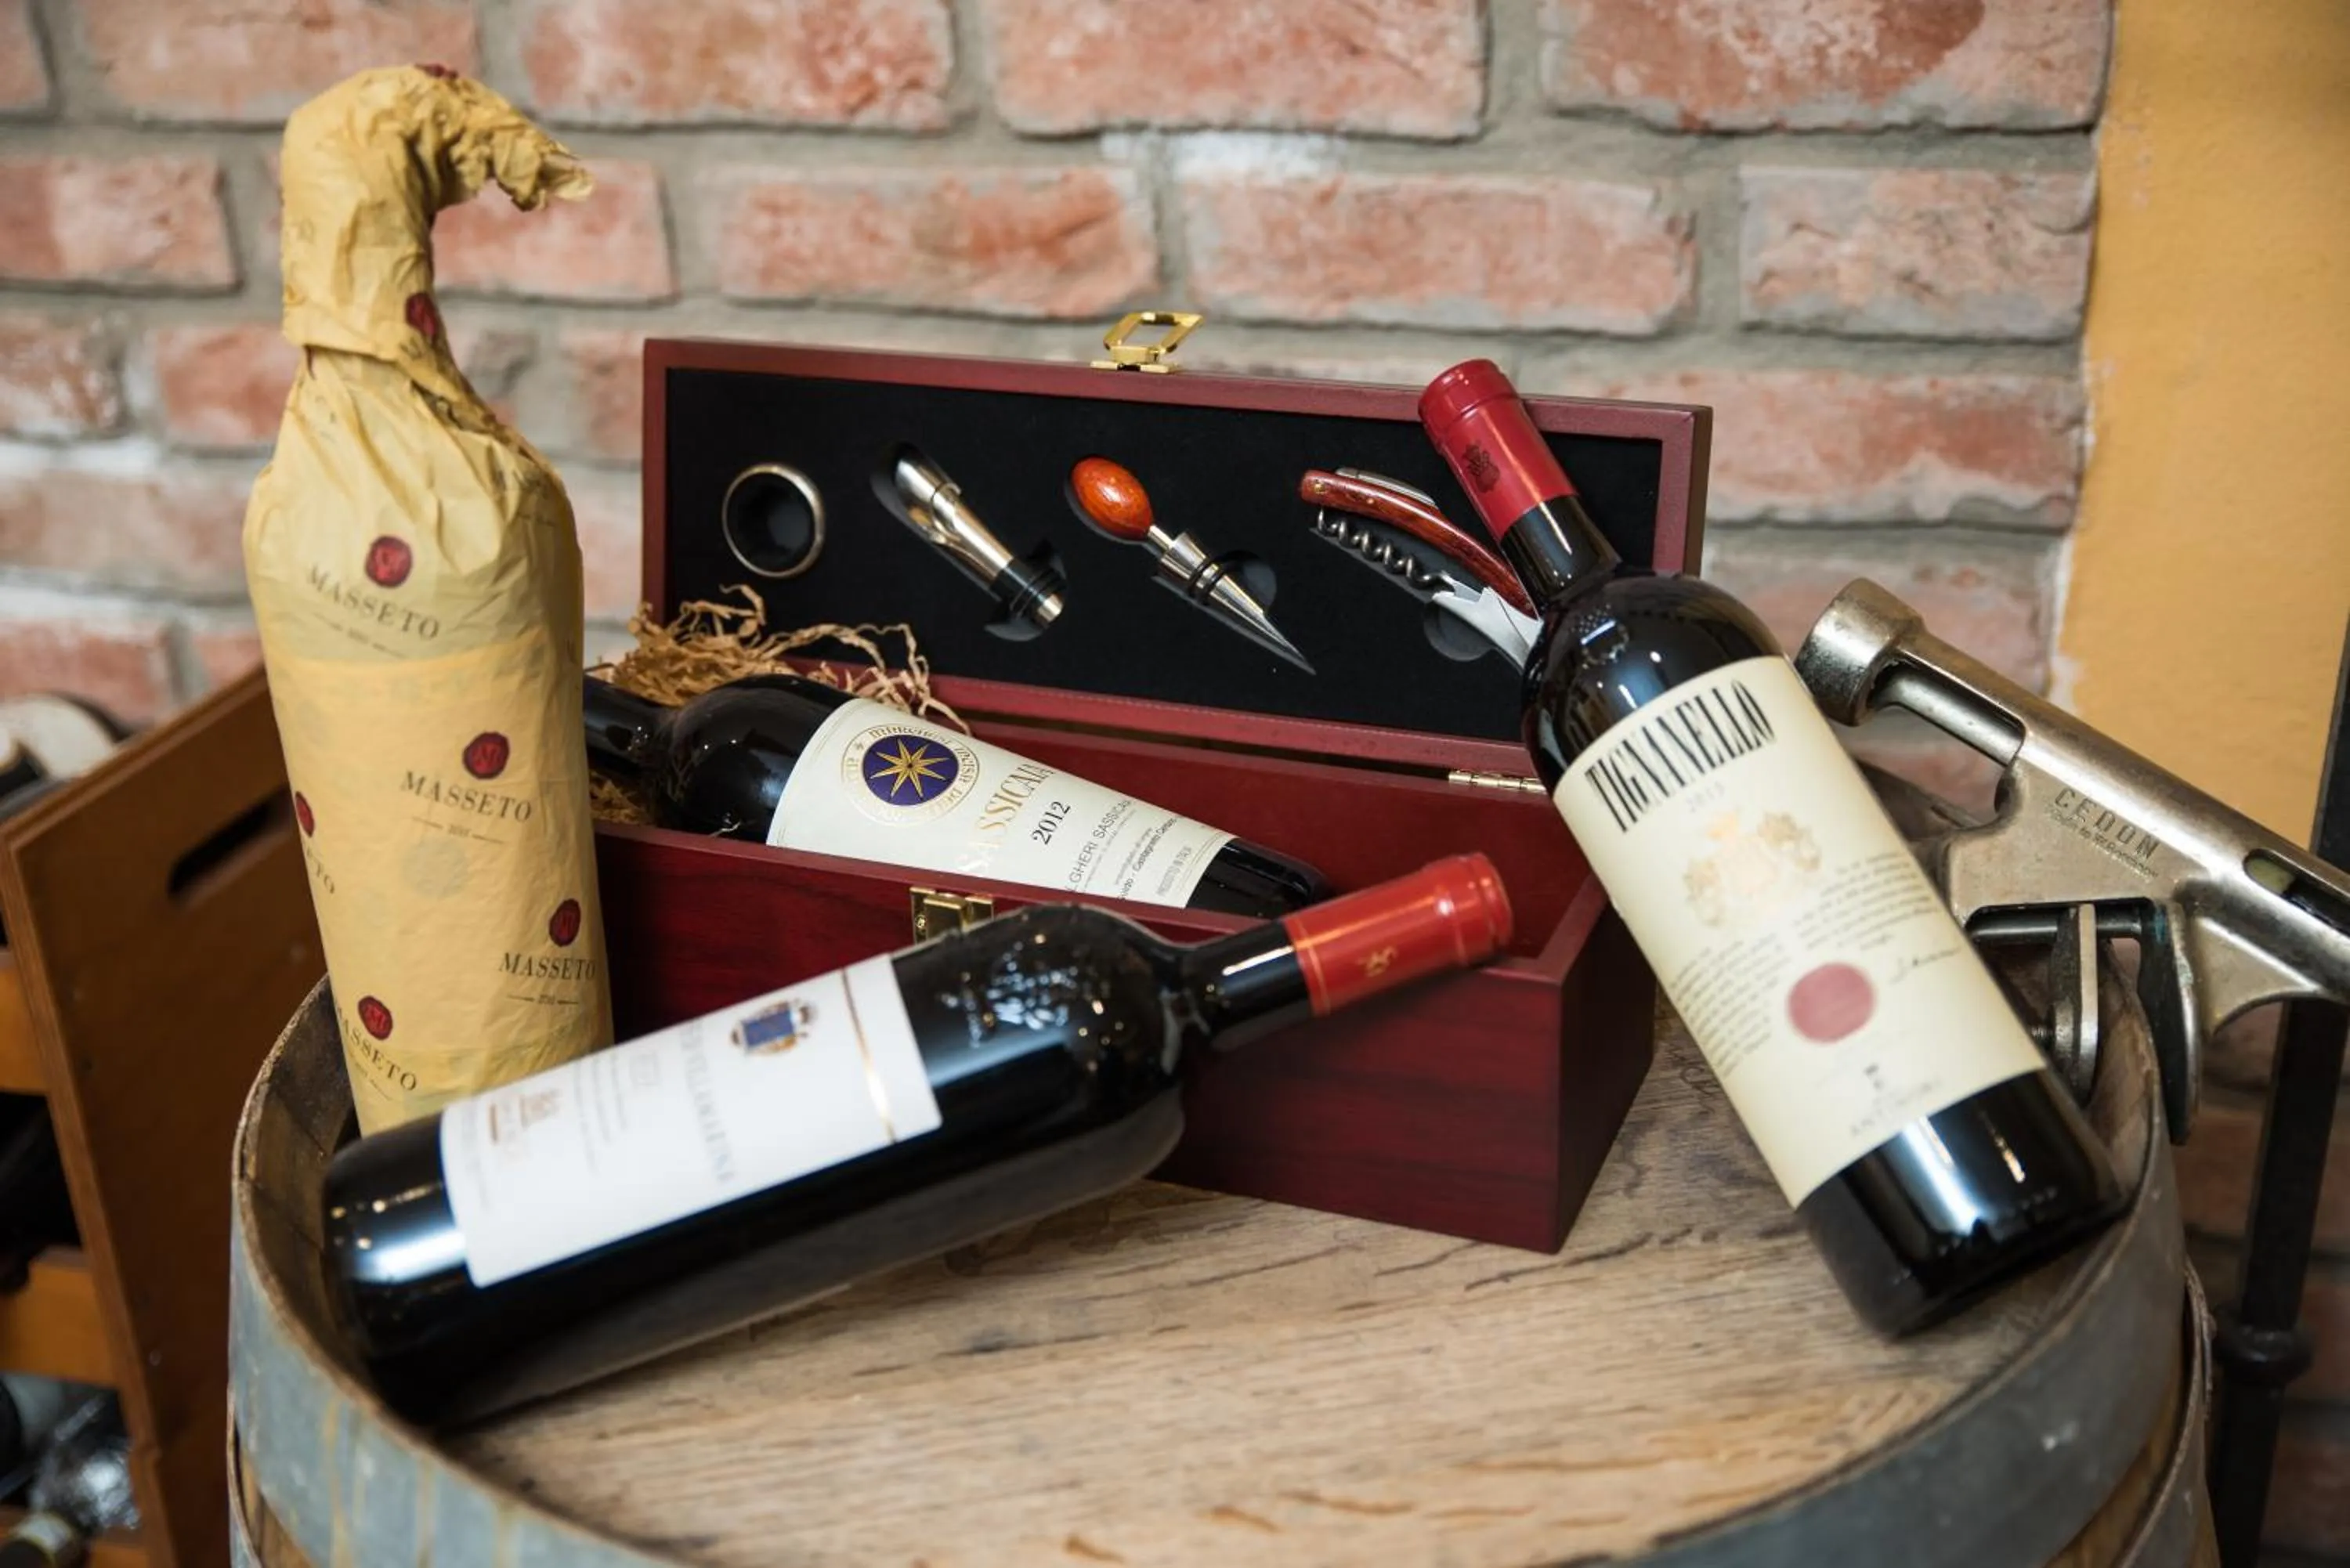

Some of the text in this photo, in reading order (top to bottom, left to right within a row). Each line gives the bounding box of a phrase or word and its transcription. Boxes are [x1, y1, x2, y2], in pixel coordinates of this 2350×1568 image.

[308, 563, 439, 640] MASSETO
[1585, 678, 1776, 833] TIGNANELLO
[400, 770, 532, 822] MASSETO
[1030, 801, 1071, 845] 2012
[1065, 842, 1097, 892] LGHERI
[498, 952, 596, 980] MASSETO
